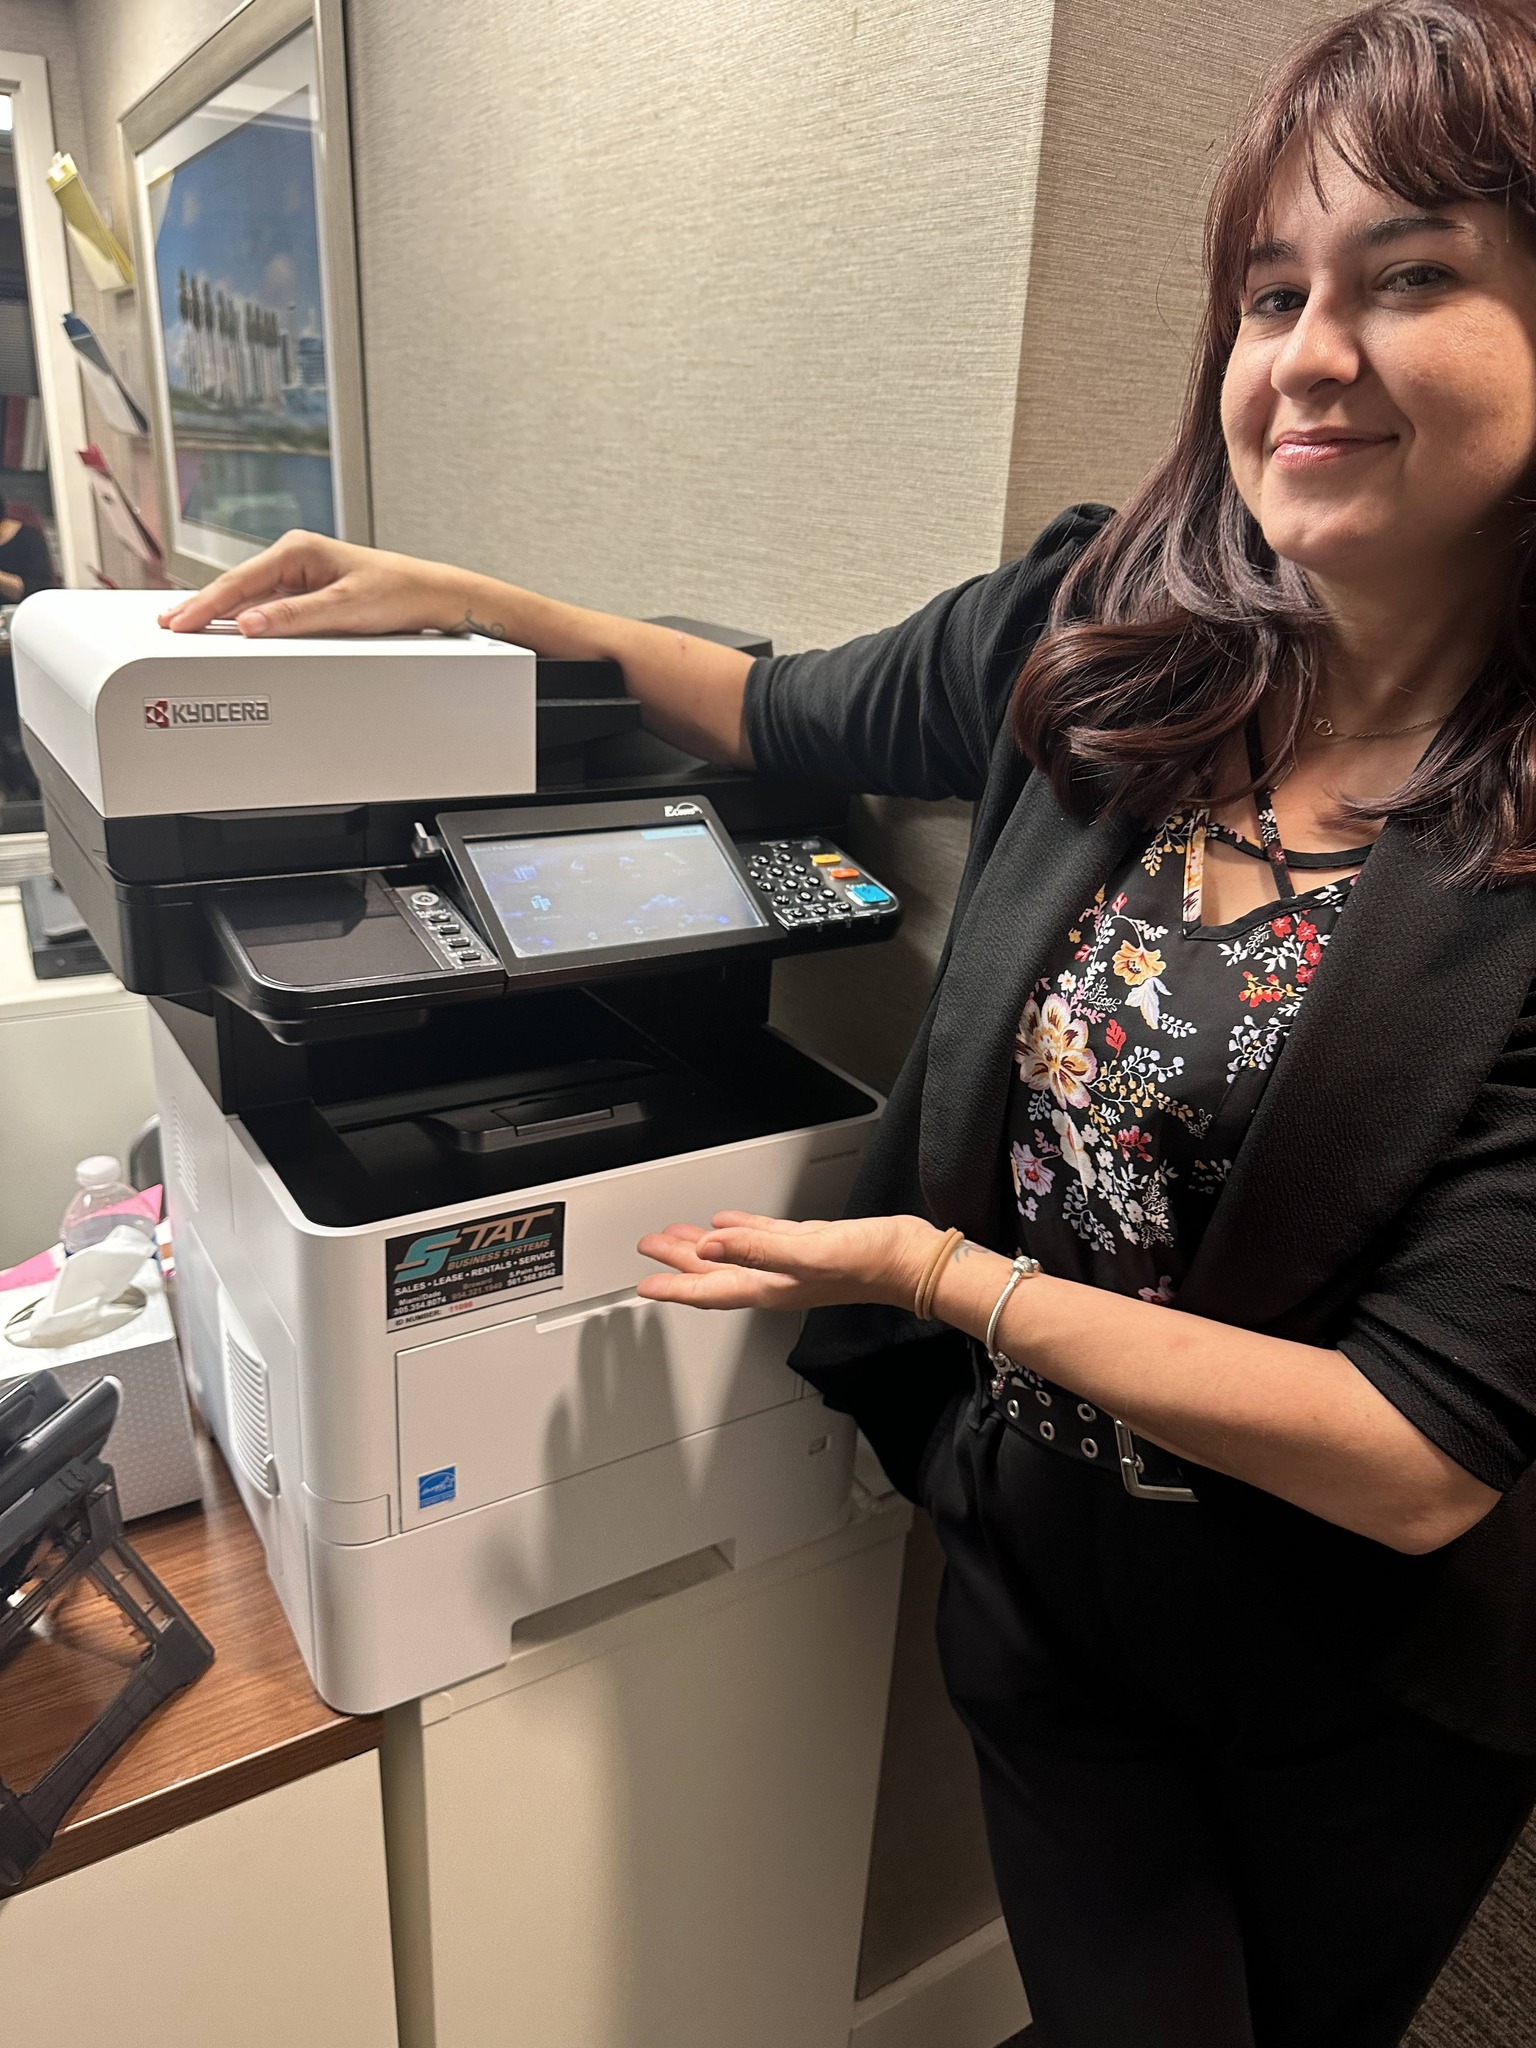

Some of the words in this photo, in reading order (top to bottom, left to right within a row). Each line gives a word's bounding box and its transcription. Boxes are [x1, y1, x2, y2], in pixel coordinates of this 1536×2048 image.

[172, 702, 269, 723] KYOCERA
[394, 1208, 556, 1284] STAT
[447, 1250, 501, 1270] BUSINESS
[502, 1239, 551, 1257] SYSTEMS
[394, 1281, 426, 1296] SALES
[433, 1272, 464, 1287] LEASE
[470, 1260, 512, 1277] RENTALS
[518, 1249, 556, 1265] SERVICE
